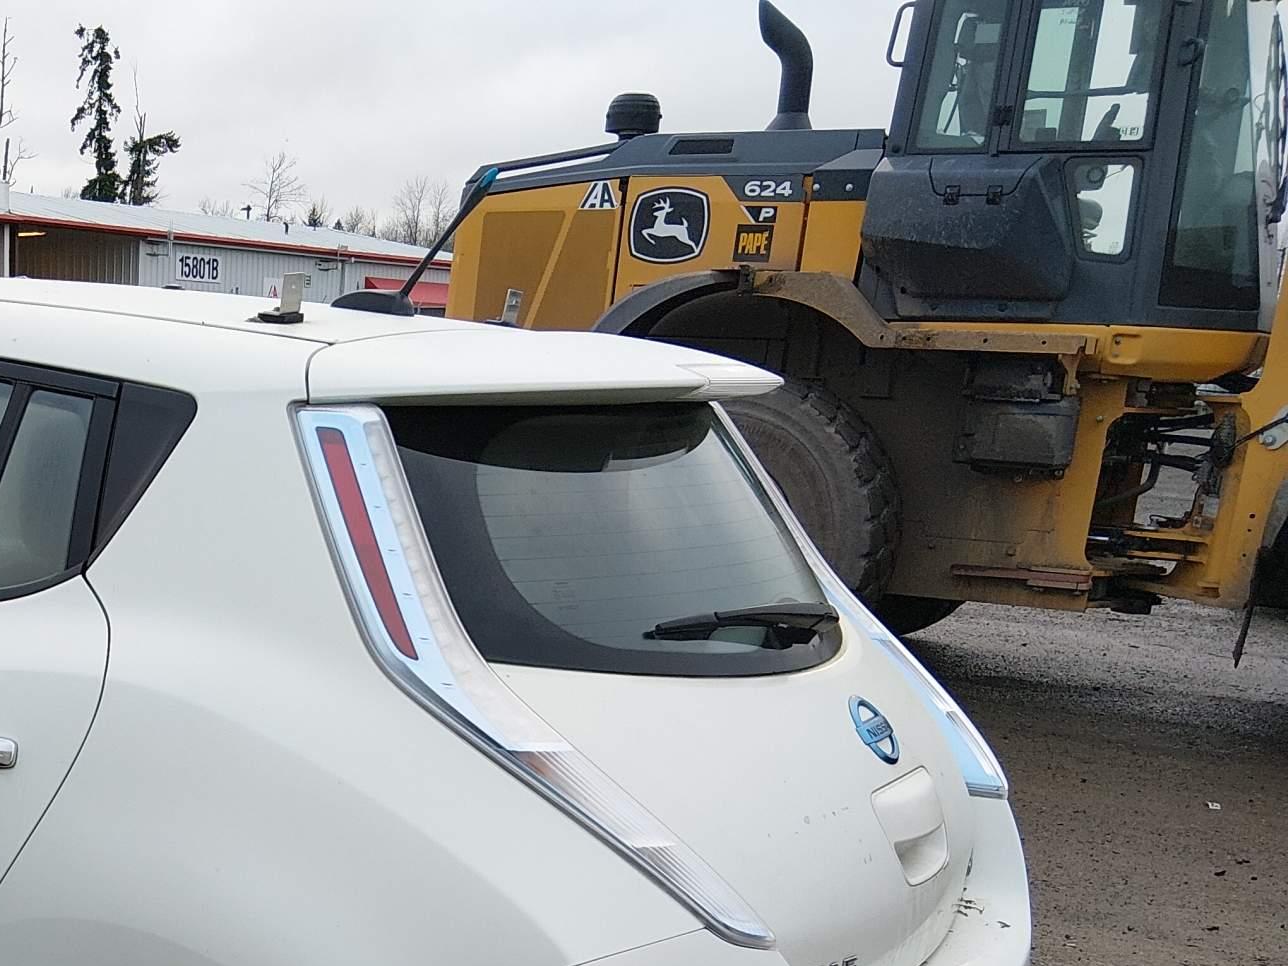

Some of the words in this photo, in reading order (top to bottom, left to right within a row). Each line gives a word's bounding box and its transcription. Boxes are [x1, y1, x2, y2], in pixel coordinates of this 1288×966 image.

[744, 180, 793, 197] 624
[758, 207, 775, 222] P
[178, 255, 219, 280] 15801B
